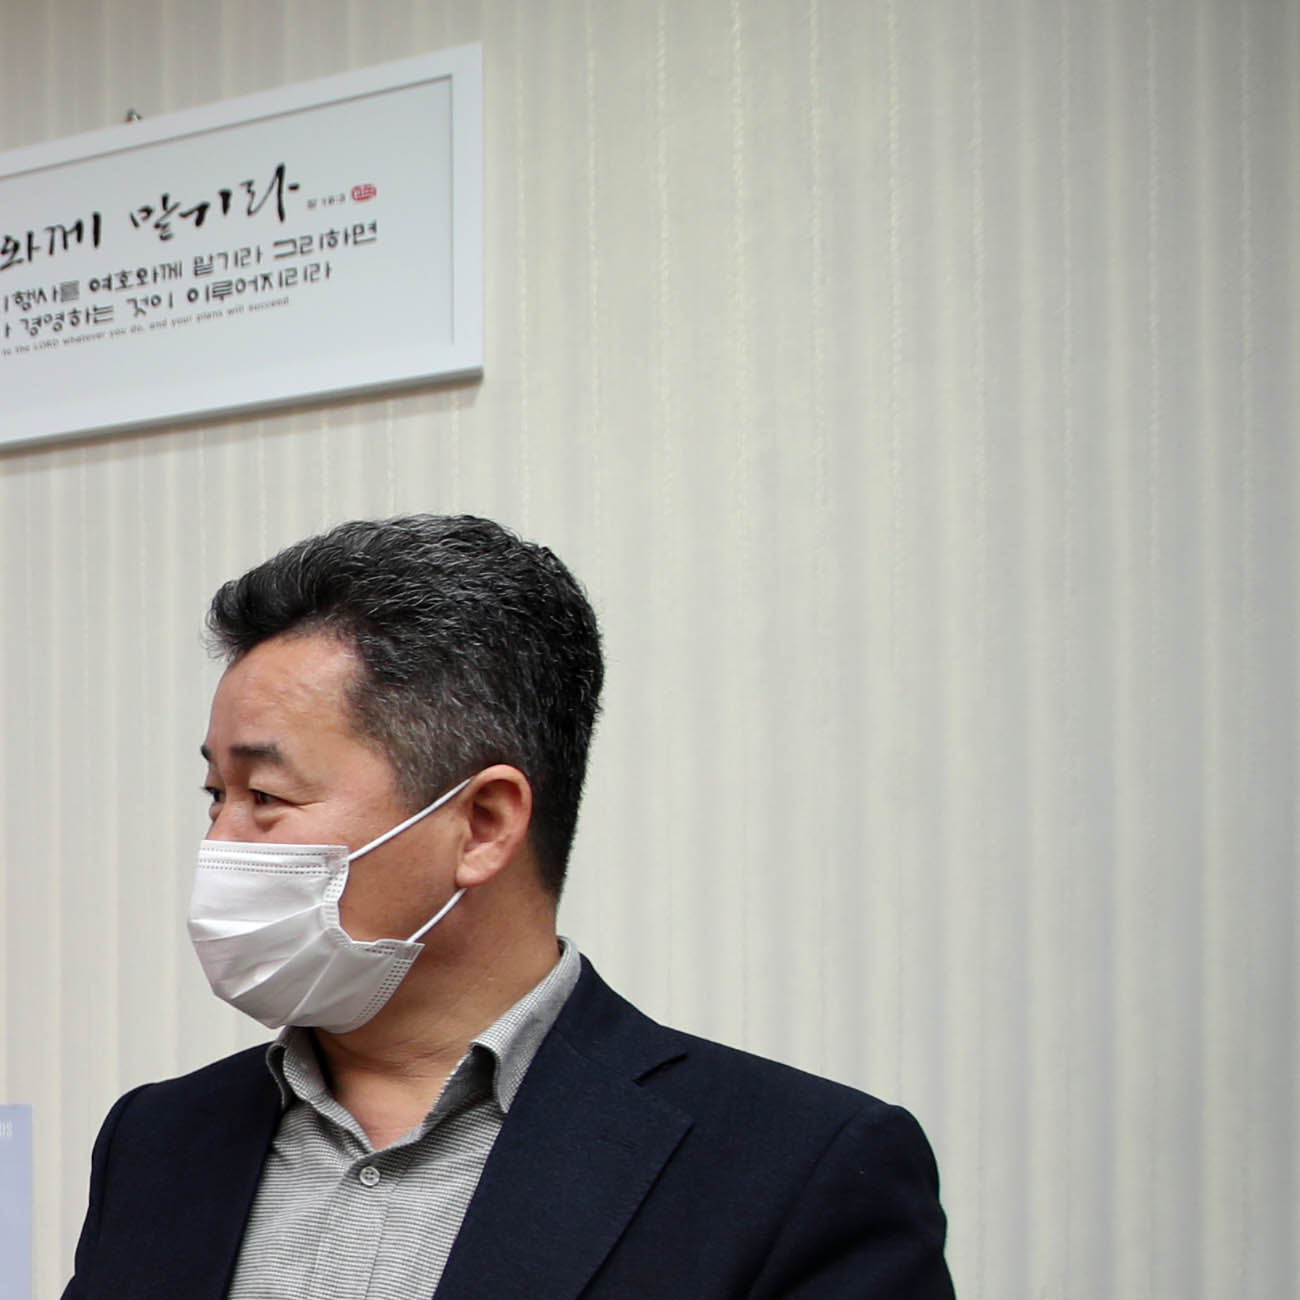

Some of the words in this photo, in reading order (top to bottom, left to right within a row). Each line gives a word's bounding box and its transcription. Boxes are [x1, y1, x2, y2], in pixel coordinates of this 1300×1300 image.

[129, 162, 300, 241] 맡기라
[88, 261, 183, 291] 여호와께
[193, 245, 261, 278] 맡기라
[273, 220, 378, 260] 그리하면
[20, 305, 114, 337] 경영하는
[126, 291, 173, 318] 것이
[187, 261, 331, 303] 이루어지리라
